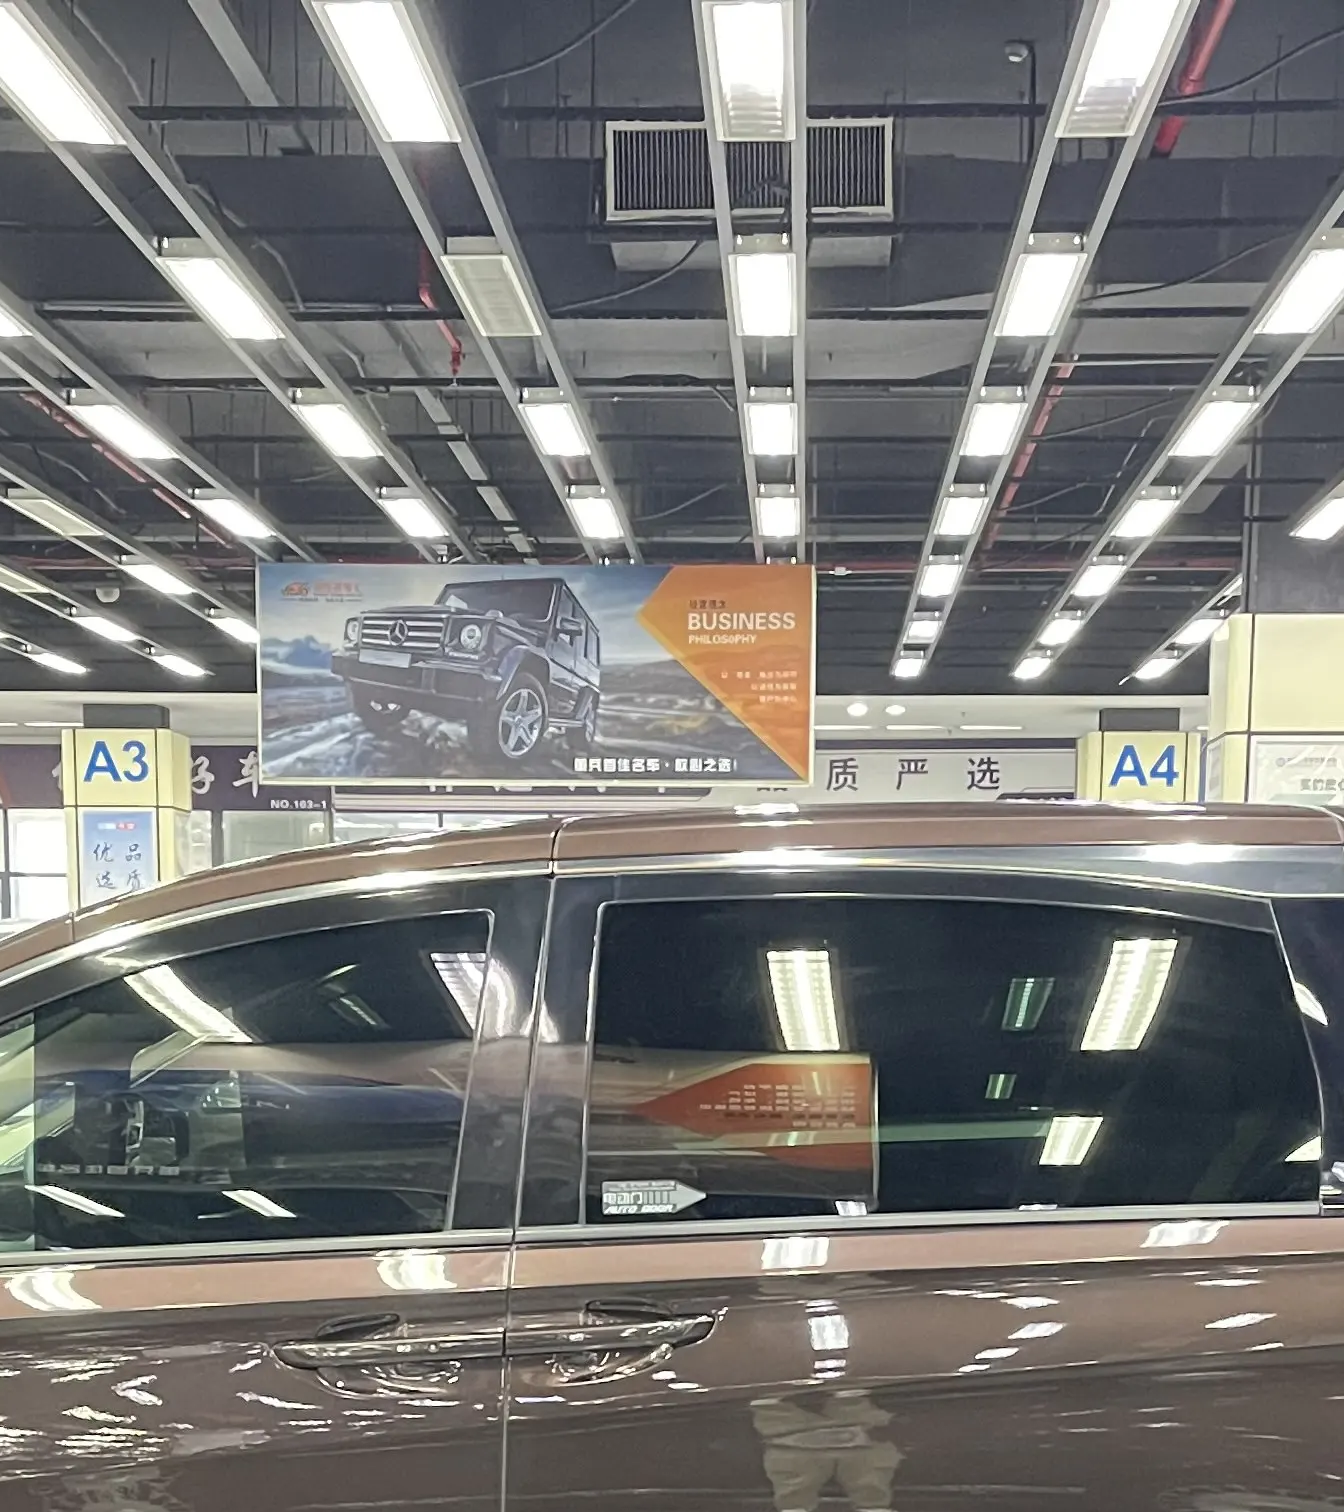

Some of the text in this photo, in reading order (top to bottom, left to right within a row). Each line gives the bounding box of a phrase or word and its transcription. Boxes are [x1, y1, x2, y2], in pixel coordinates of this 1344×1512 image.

[688, 612, 796, 631] BUSINESS
[83, 740, 149, 783] A3
[757, 756, 1002, 792] 质严选
[1108, 744, 1180, 788] A4
